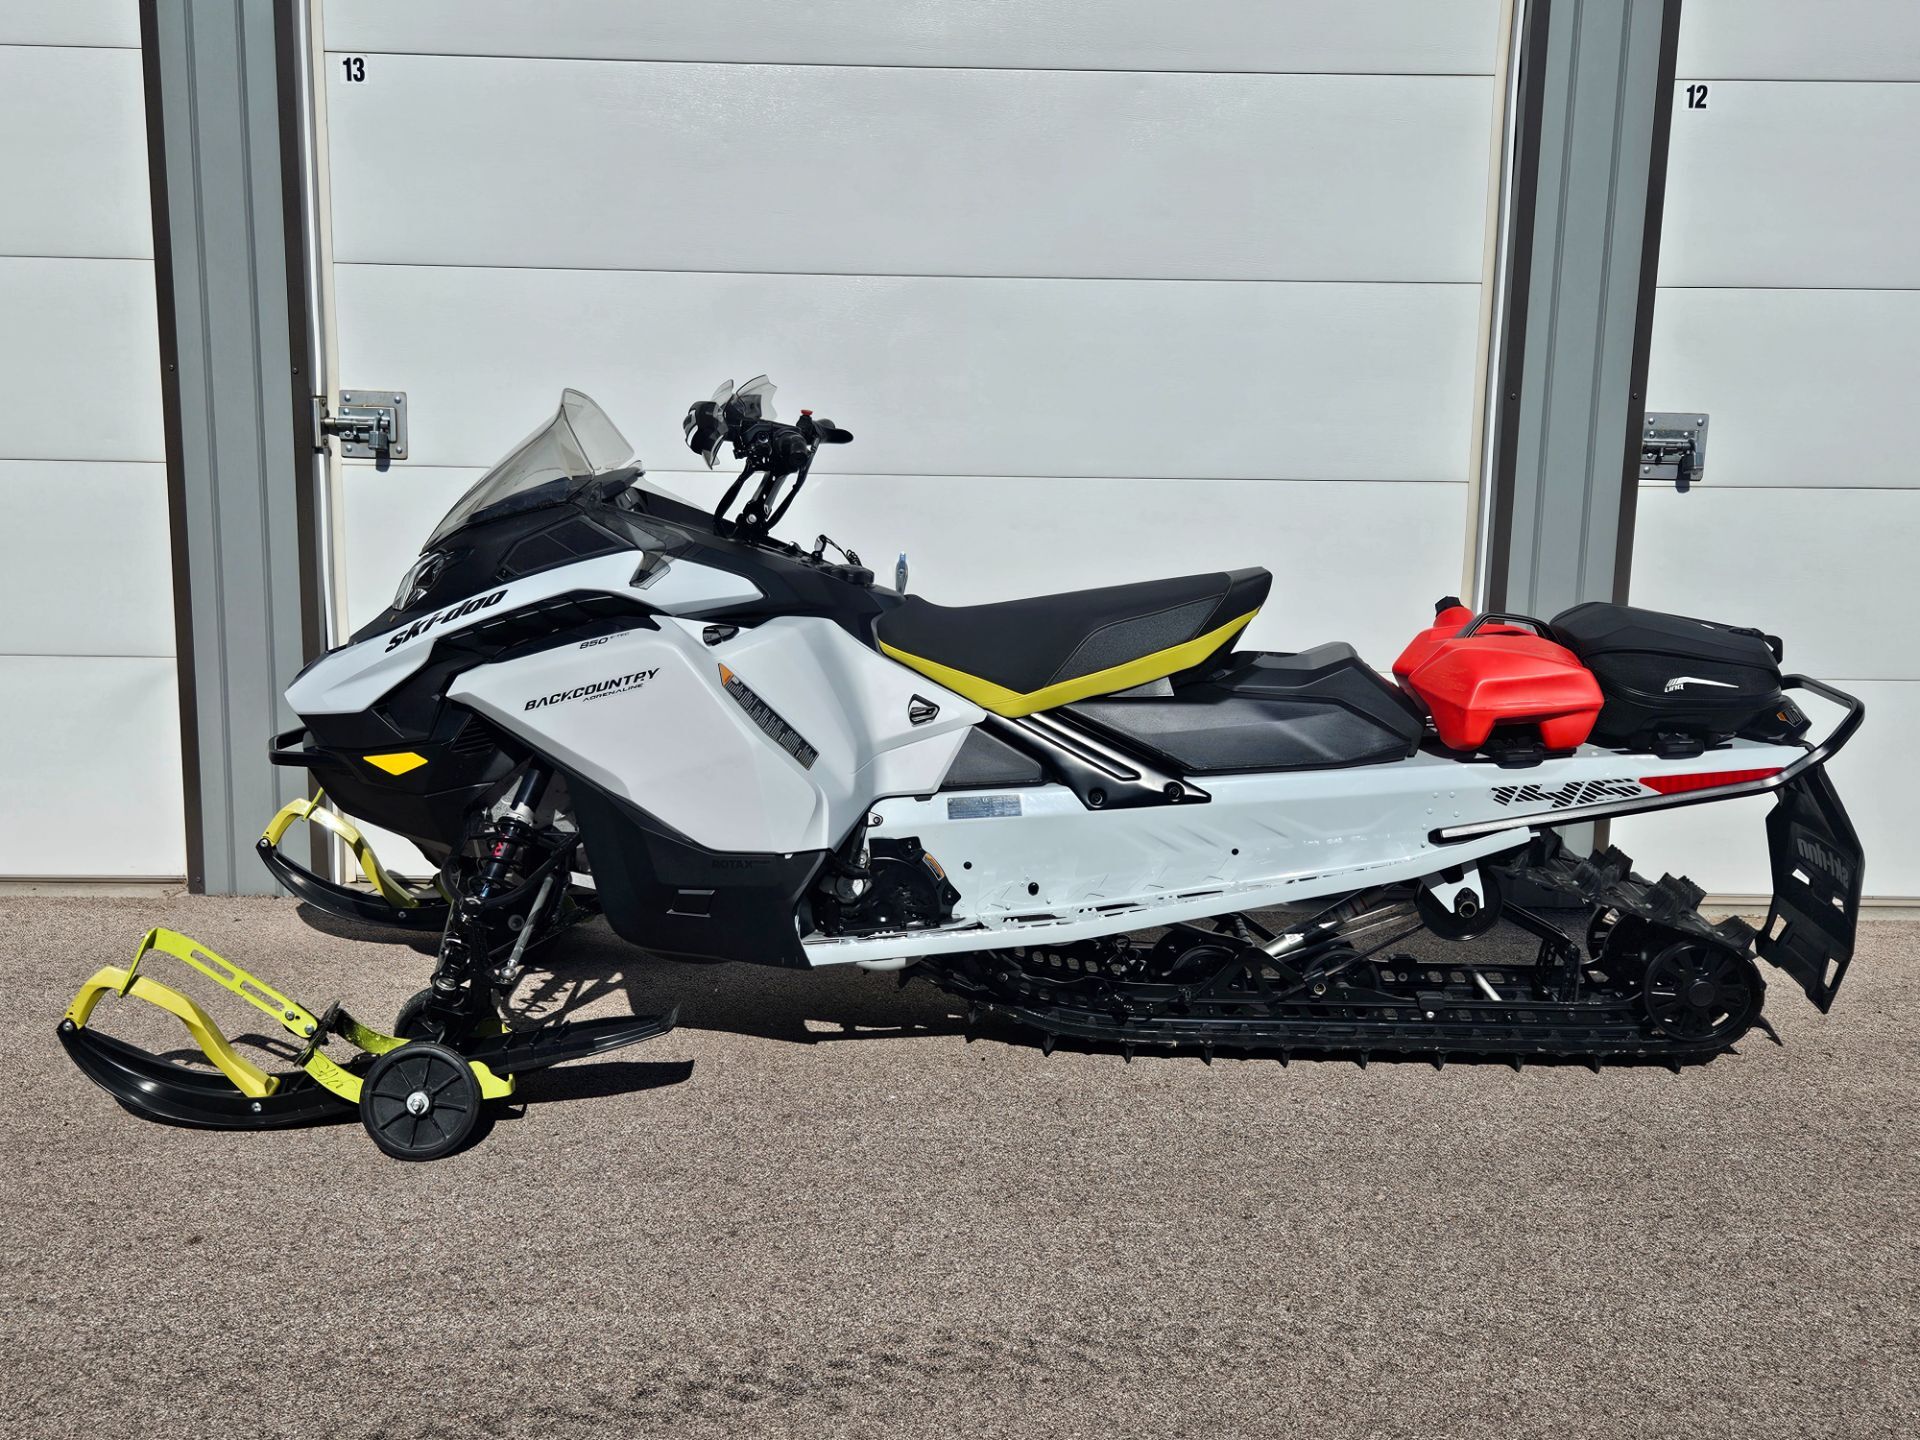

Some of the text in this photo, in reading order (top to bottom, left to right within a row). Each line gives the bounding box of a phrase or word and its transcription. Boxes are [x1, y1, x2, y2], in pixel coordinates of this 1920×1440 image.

[342, 57, 366, 82] 13
[1686, 84, 1708, 109] 12
[579, 637, 608, 649] 850
[524, 667, 660, 711] BACKCOUNTRY
[582, 683, 643, 702] ADRENALINE
